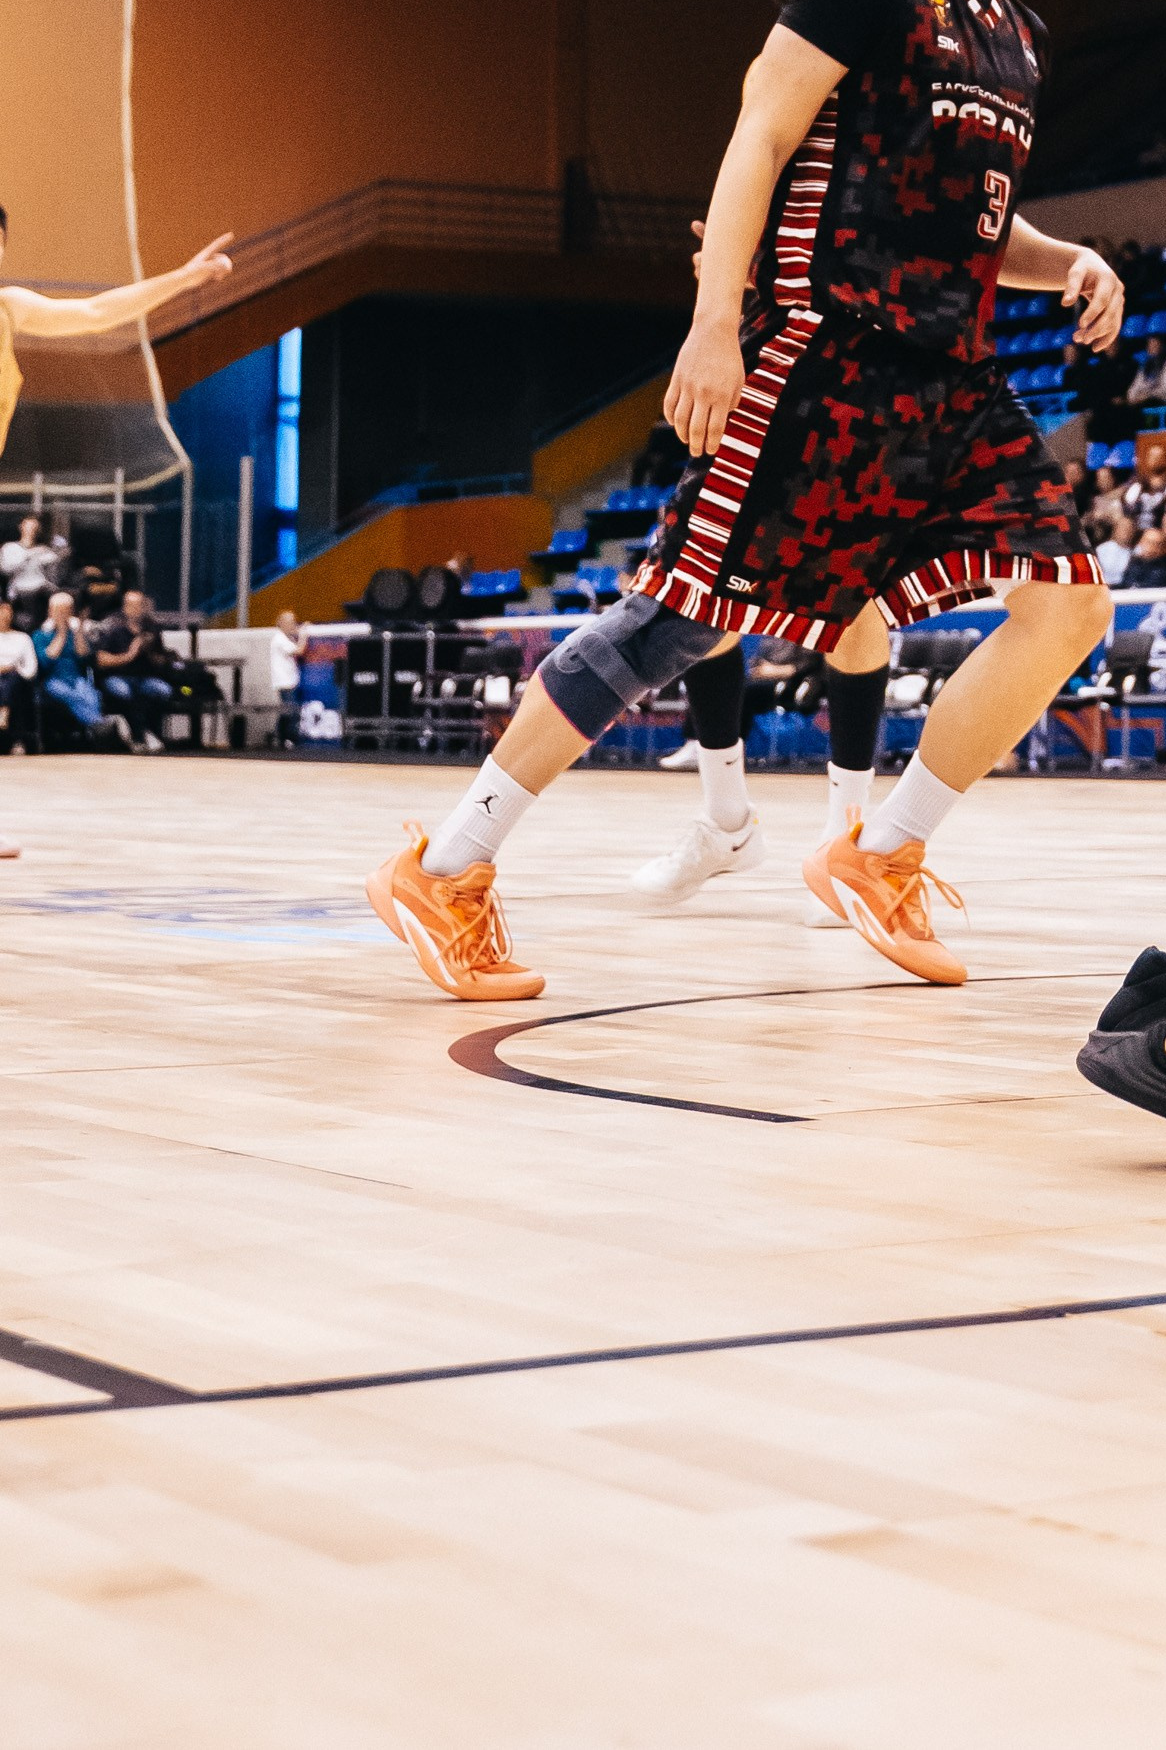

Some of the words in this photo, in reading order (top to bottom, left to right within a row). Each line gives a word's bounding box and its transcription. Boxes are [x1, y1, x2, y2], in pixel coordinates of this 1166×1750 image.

[937, 35, 960, 54] STK
[977, 169, 1011, 242] 3
[725, 575, 760, 593] STK
